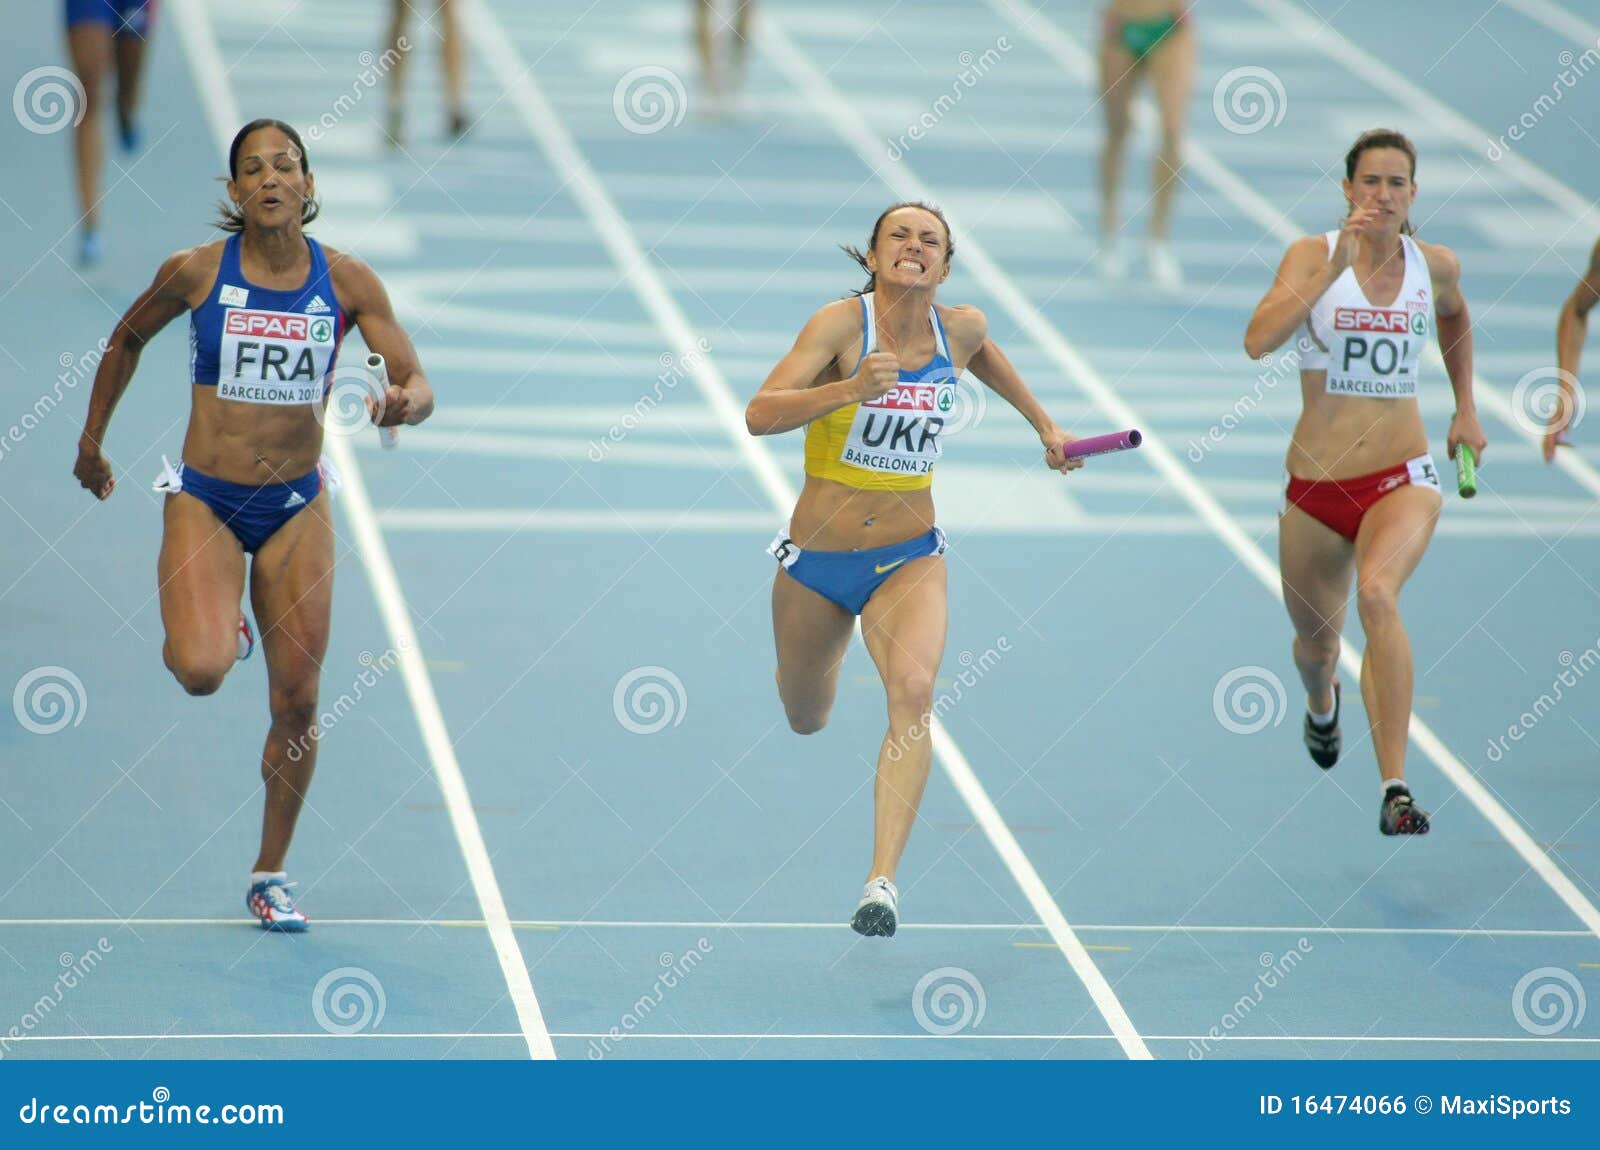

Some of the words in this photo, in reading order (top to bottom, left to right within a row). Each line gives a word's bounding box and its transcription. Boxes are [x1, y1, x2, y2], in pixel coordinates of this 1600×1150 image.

[229, 314, 306, 337] SPAR
[1336, 310, 1408, 331] SPAR
[234, 341, 316, 381] FRA
[1343, 337, 1408, 375] POL
[221, 383, 296, 401] BARCELONA
[298, 387, 321, 401] 2010
[862, 413, 944, 453] UKR
[846, 448, 917, 472] BARCELONA
